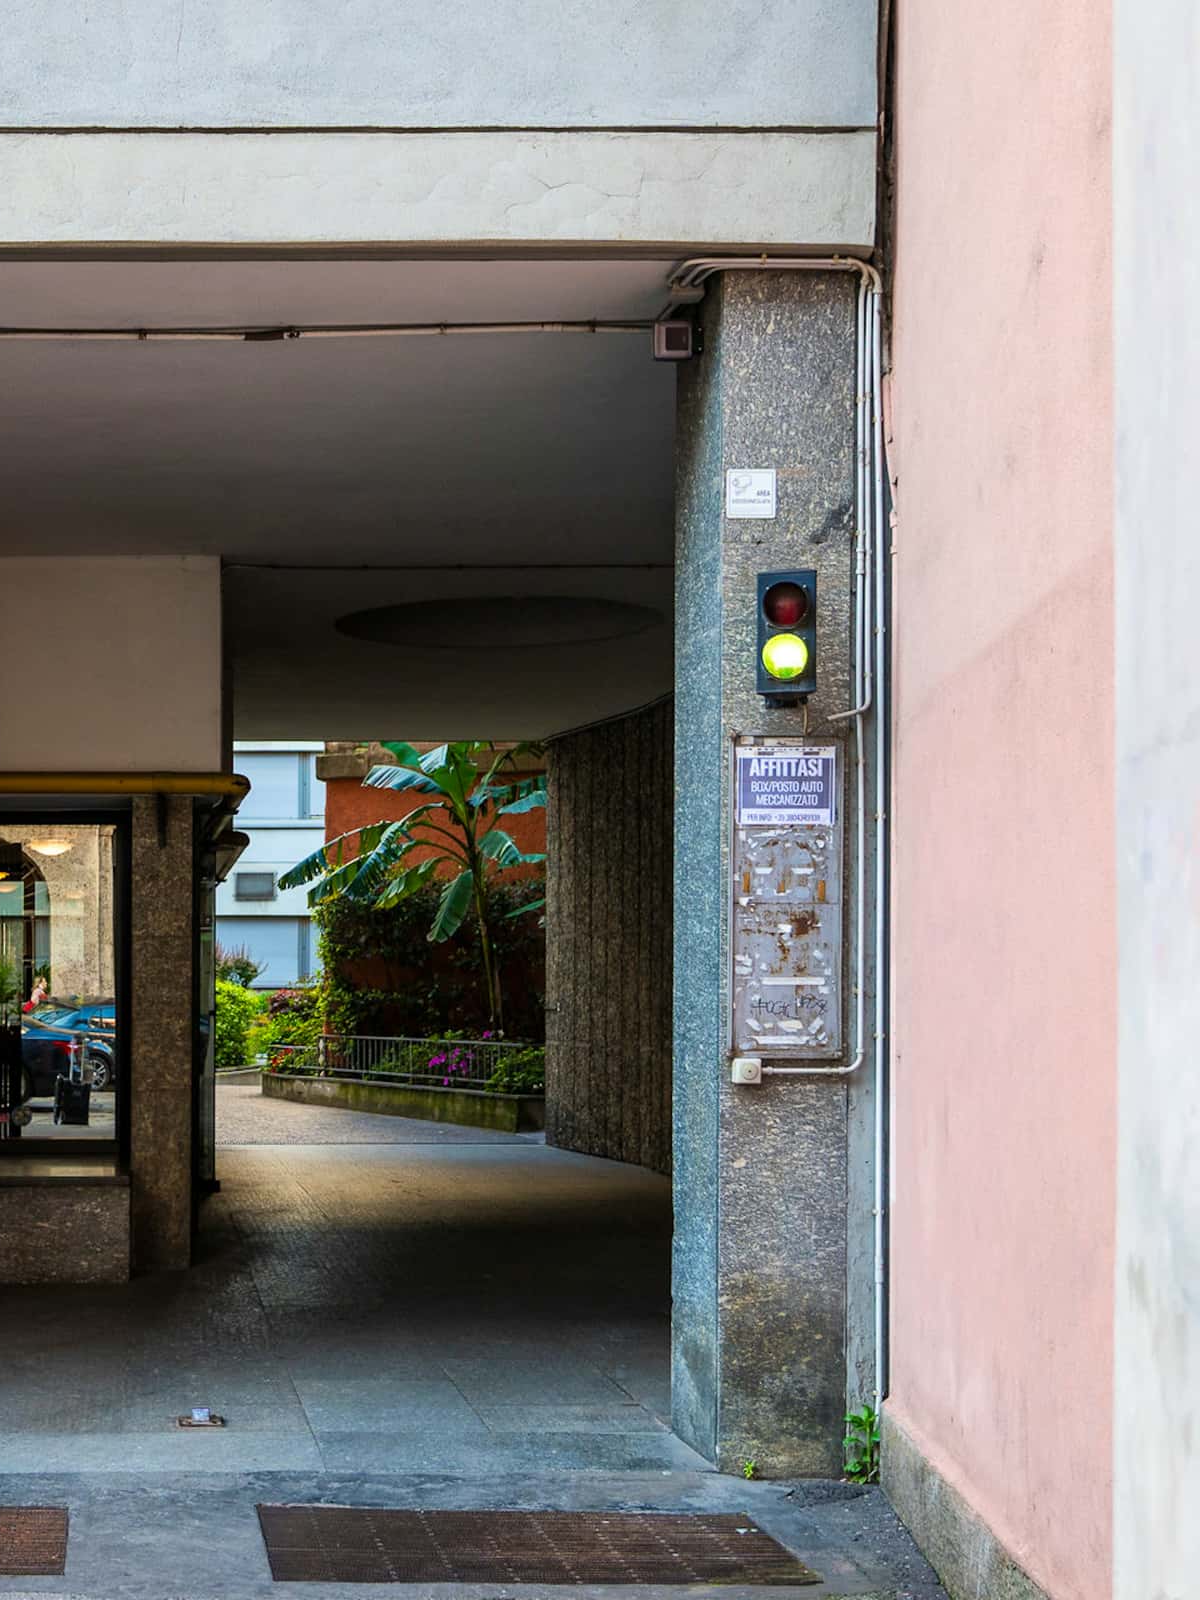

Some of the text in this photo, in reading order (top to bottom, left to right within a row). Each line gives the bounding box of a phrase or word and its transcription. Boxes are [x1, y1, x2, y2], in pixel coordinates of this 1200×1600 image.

[749, 758, 823, 776] AFFITTASI
[751, 781, 824, 792] BOX/POSTO AUTO
[755, 794, 818, 806] MECCANIZZATO
